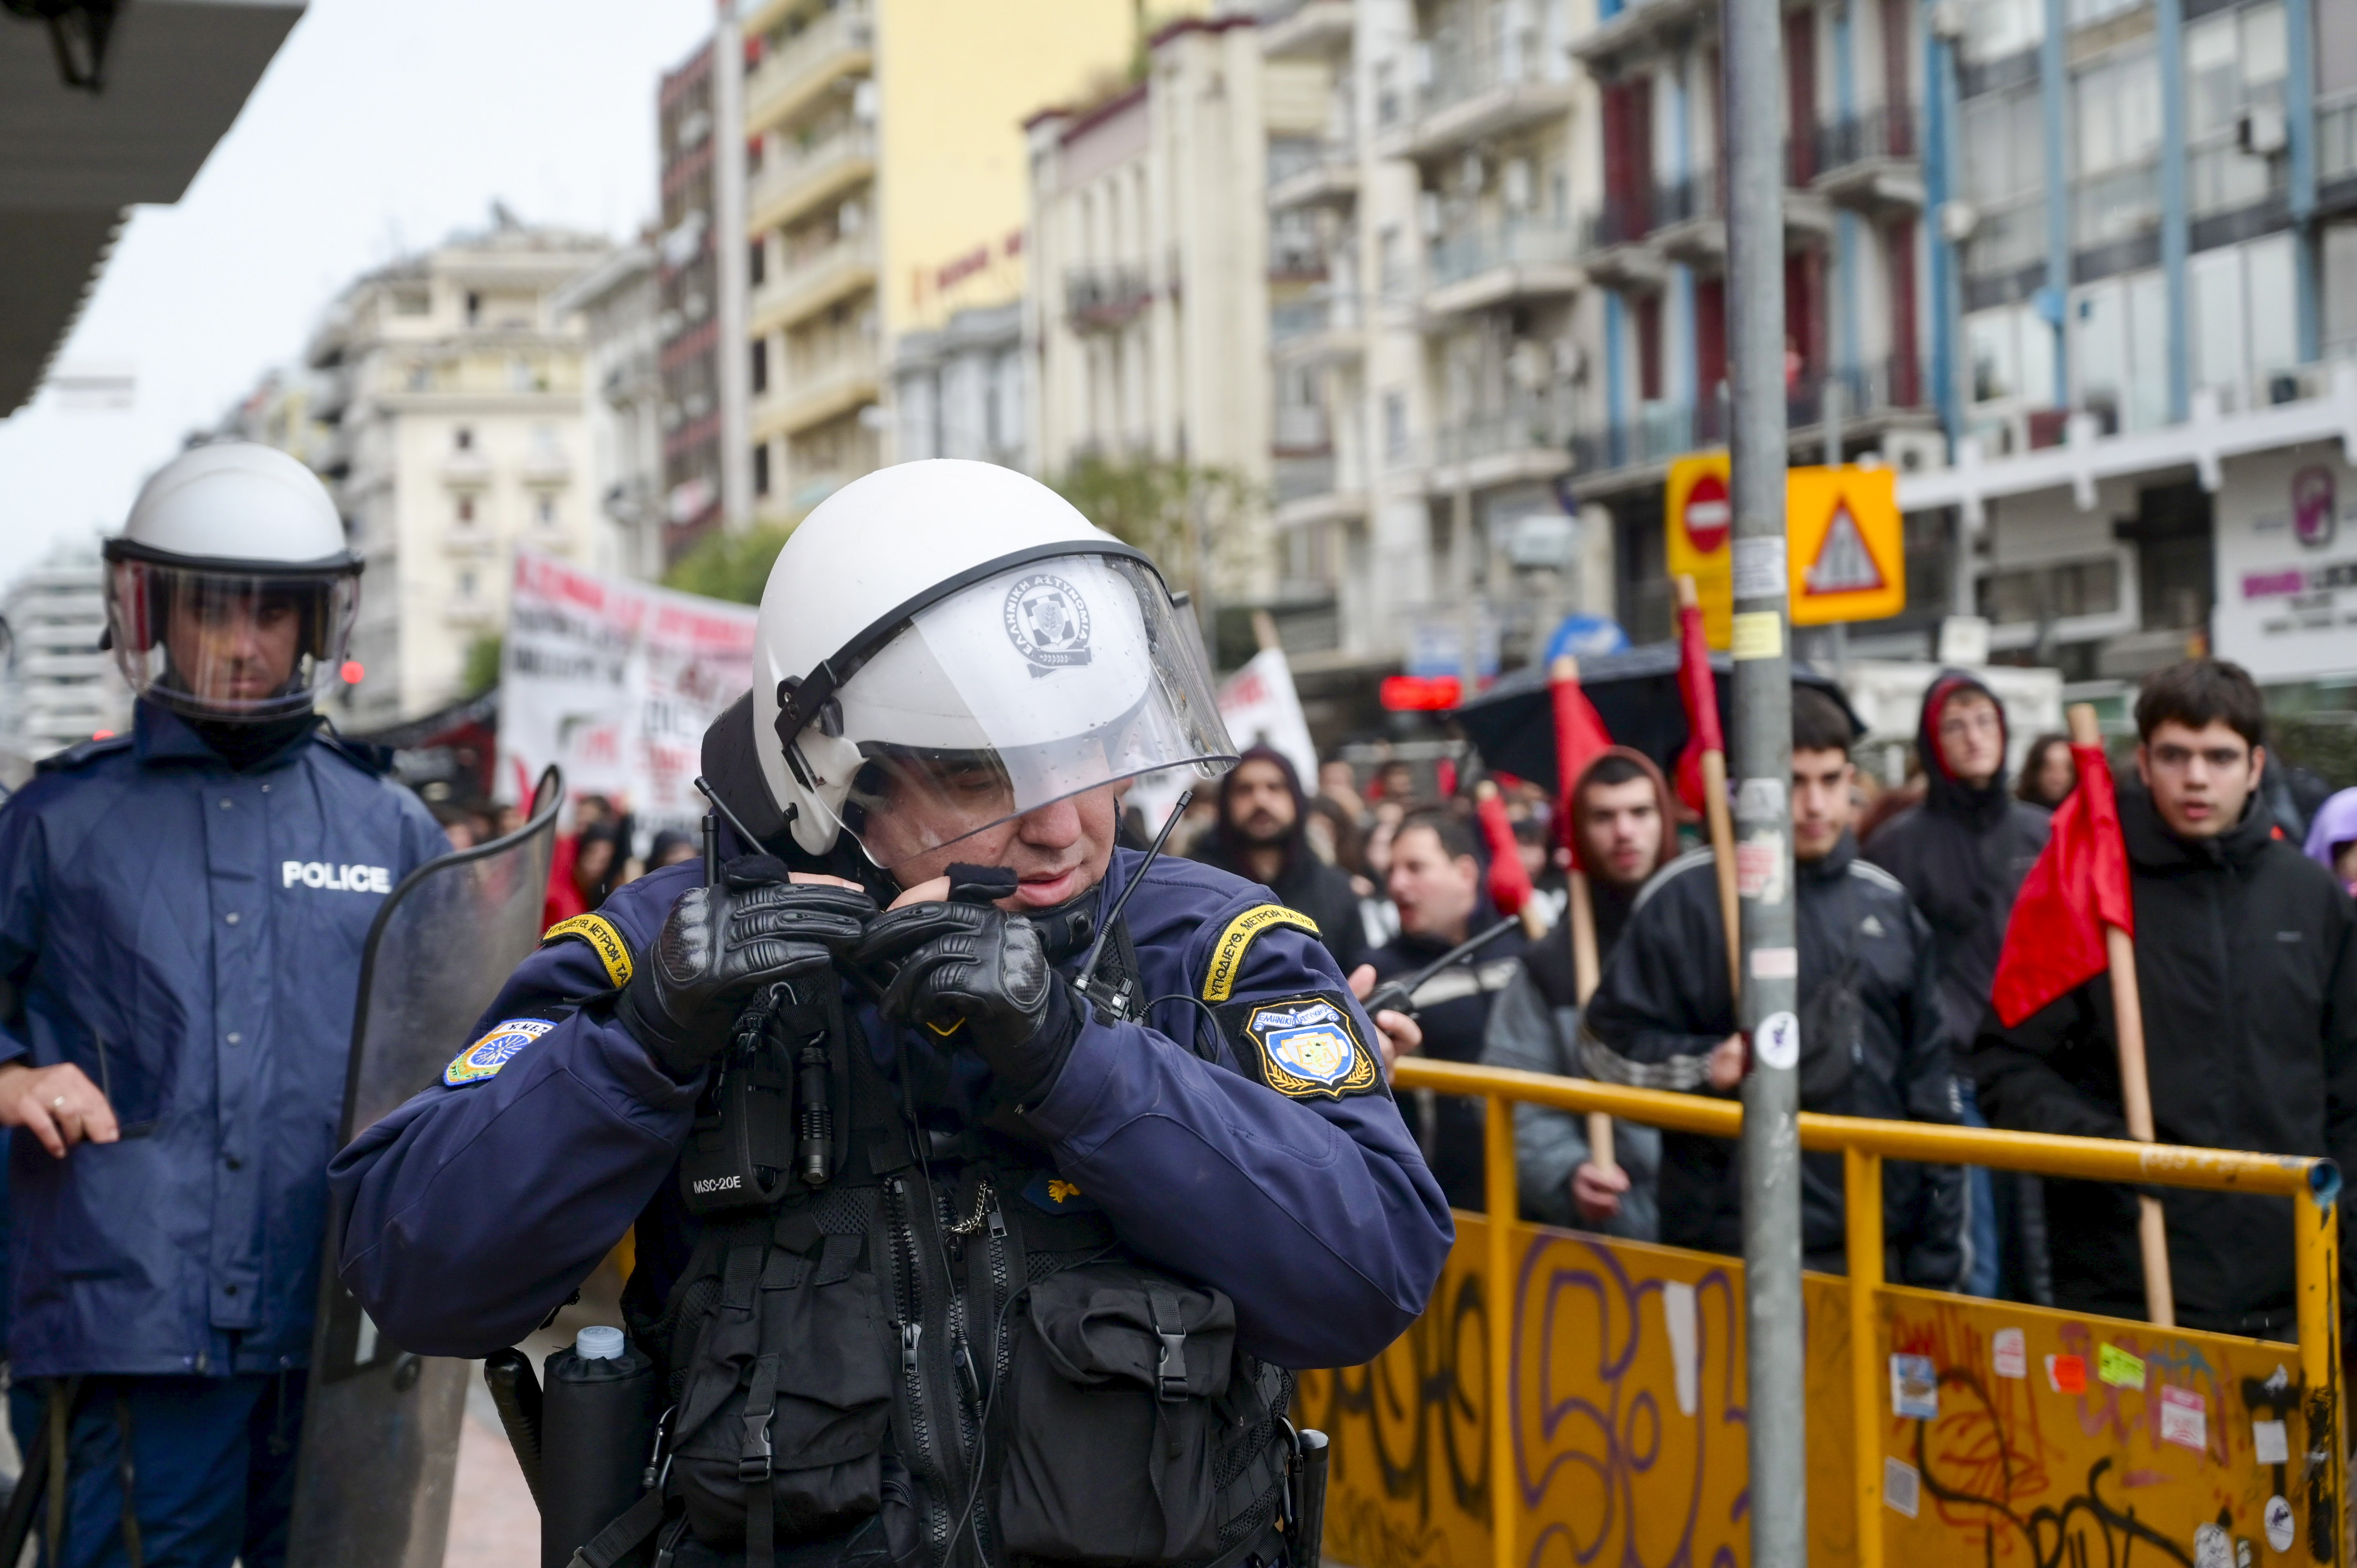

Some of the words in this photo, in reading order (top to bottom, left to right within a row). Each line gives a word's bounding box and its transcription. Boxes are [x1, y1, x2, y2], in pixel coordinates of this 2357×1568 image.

[1006, 580, 1033, 654] ΕΛΛΗΝΙΚΗ
[1034, 575, 1089, 639] ΑΣΤΥΝΟΜΙΑ
[282, 861, 392, 894] POLICE
[1240, 909, 1282, 930] ΜΕΤΡΩΝ
[588, 922, 621, 963] ΜΕΤΡΩΝ
[693, 1175, 741, 1194] MSC-20E
